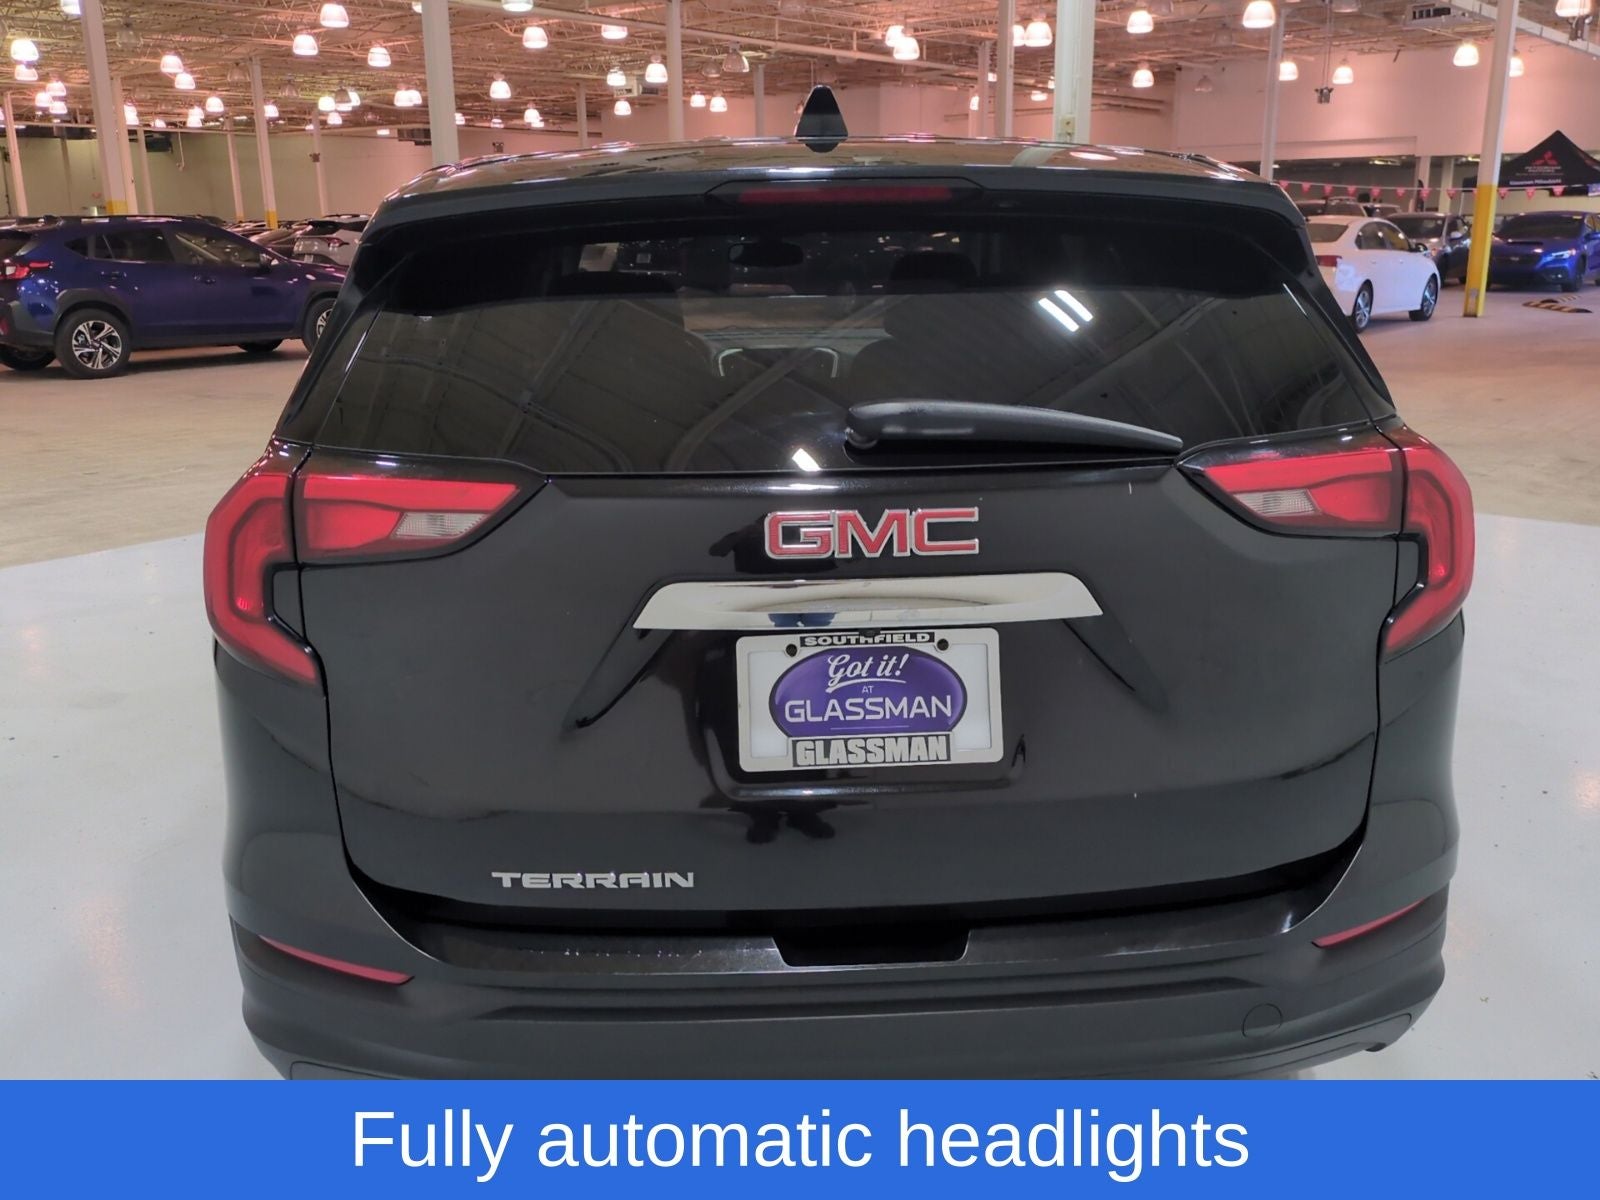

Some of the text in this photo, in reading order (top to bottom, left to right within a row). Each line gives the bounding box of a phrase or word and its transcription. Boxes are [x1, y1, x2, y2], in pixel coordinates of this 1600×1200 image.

[764, 507, 979, 559] GMC
[827, 653, 909, 686] Got it!
[861, 685, 874, 694] AT
[784, 695, 952, 723] GLASSMAN
[795, 735, 947, 766] GLASSMAN
[491, 871, 694, 888] TERRAIN
